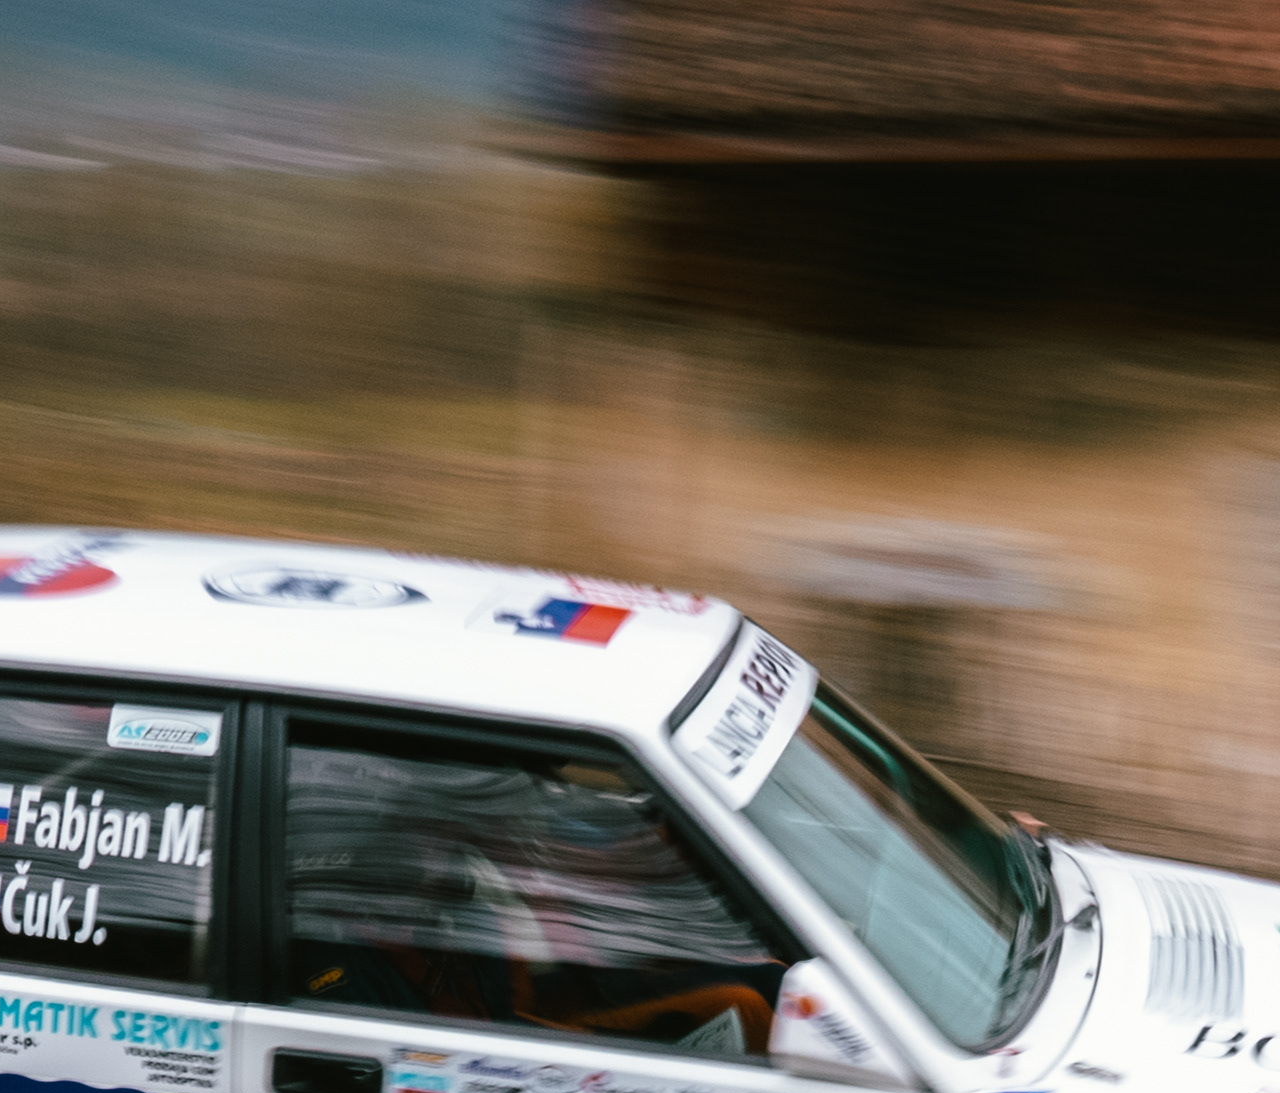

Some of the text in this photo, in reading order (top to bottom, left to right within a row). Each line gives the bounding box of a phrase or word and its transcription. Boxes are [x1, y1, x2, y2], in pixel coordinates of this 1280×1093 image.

[692, 695, 776, 778] LANCIA
[14, 784, 213, 870] Fabjan M.
[1, 861, 108, 946] Čuk J.
[11, 1034, 38, 1050] s.p.
[110, 1010, 223, 1053] SERVIS
